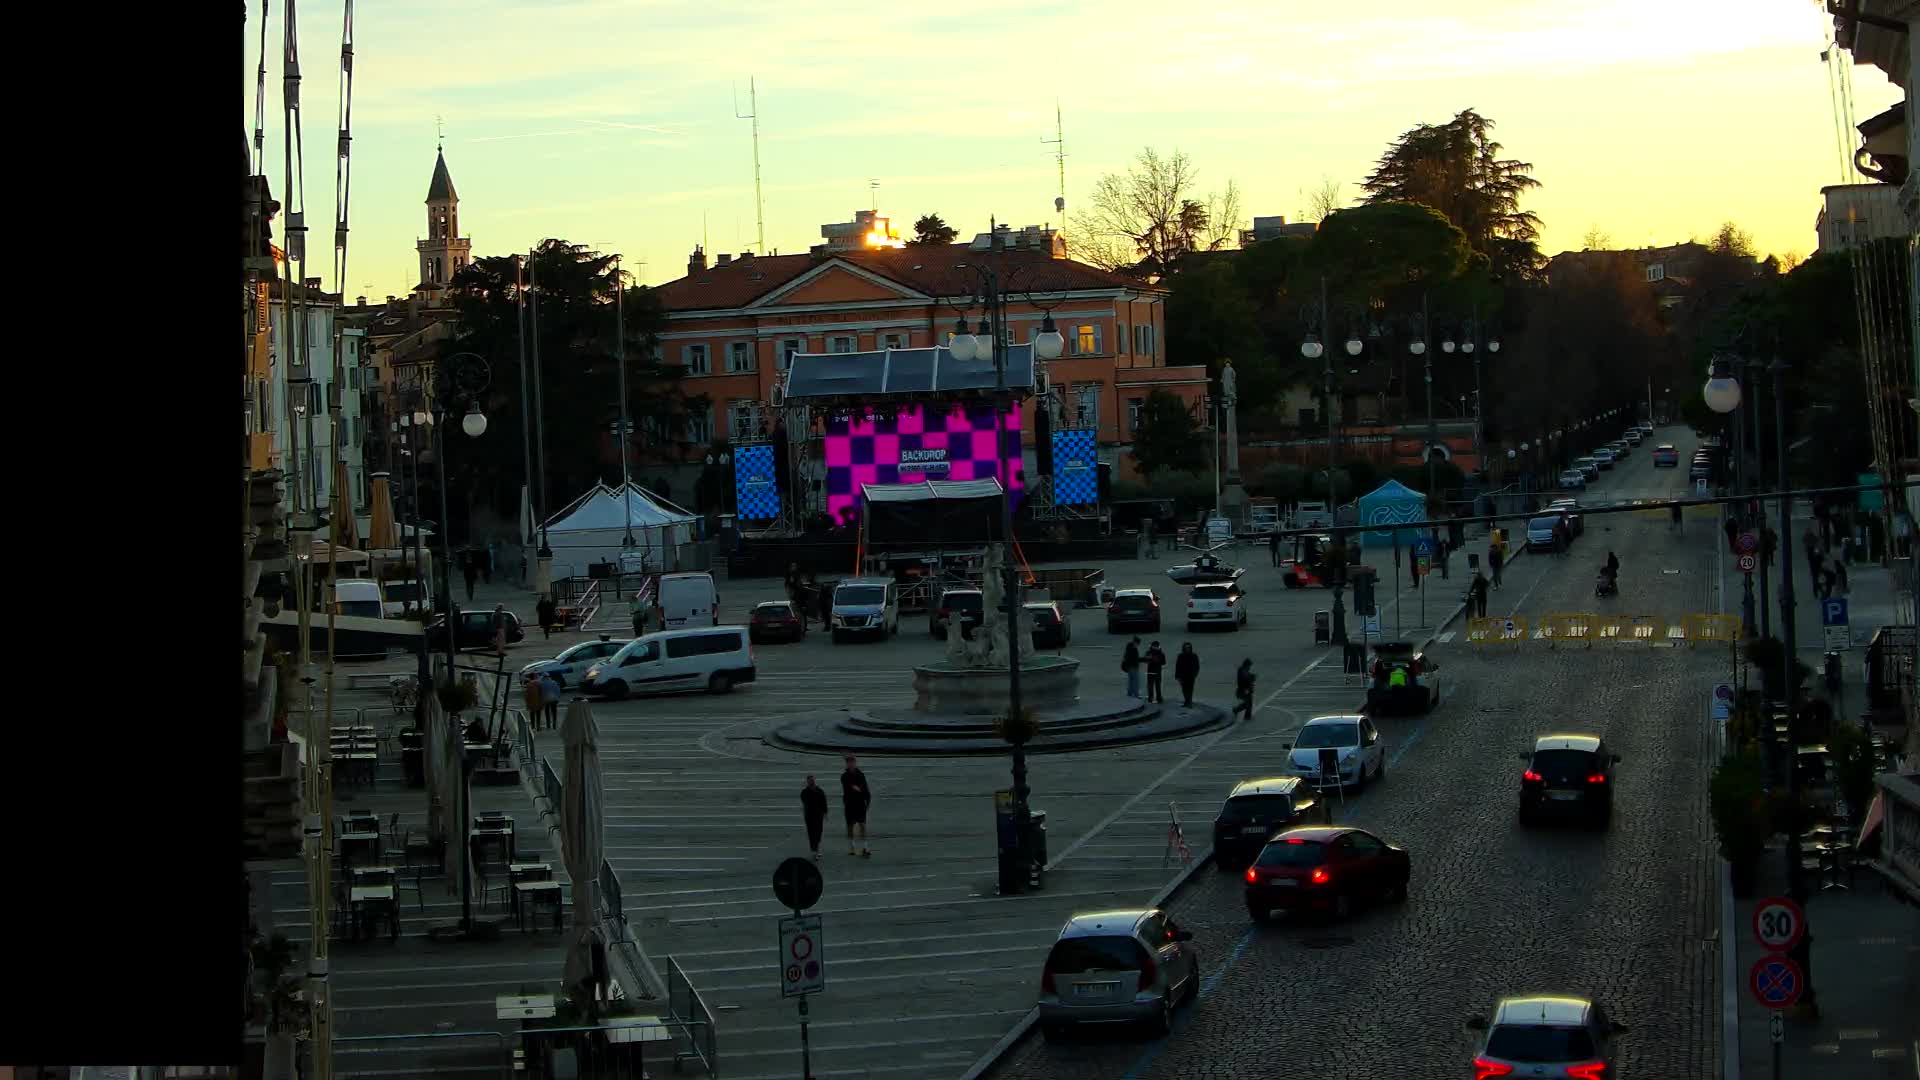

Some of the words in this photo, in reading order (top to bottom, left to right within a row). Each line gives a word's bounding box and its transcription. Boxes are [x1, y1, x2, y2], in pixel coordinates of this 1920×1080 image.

[902, 449, 946, 461] BACKDROP
[1743, 558, 1753, 567] 20
[1827, 602, 1842, 623] P
[1763, 912, 1791, 937] 30
